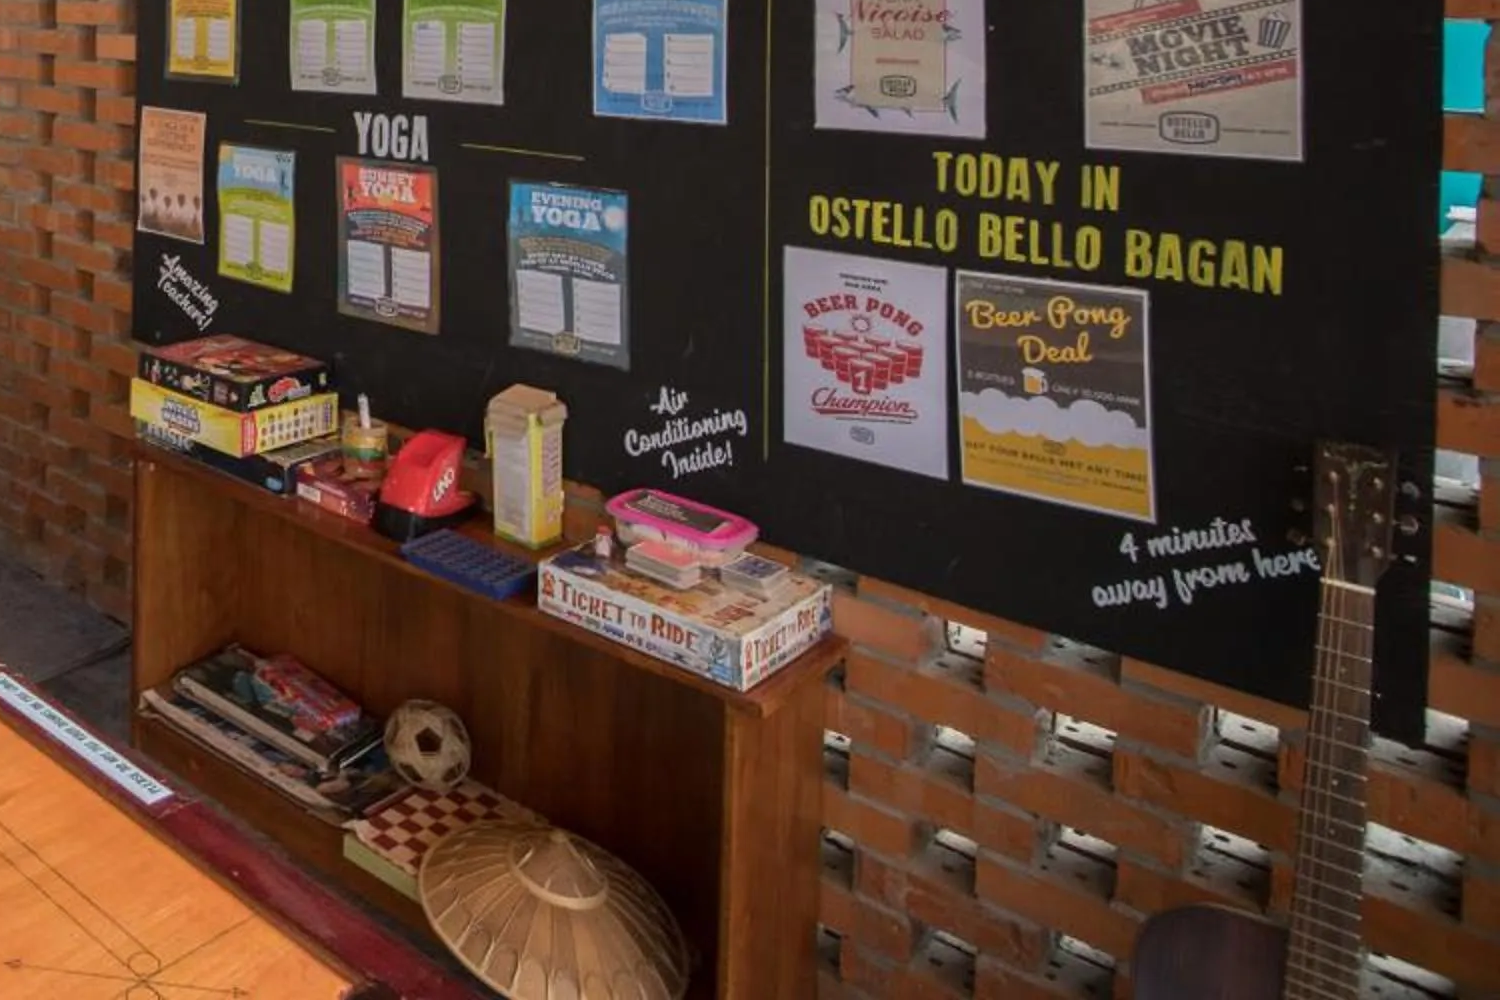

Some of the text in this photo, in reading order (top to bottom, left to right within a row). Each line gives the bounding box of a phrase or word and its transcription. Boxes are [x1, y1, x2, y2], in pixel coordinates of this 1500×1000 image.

[871, 27, 925, 41] SALAD
[1127, 15, 1247, 55] MOVIE
[1129, 35, 1250, 77] NIGHT
[354, 111, 429, 161] YOGA
[361, 181, 416, 203] YOGA
[532, 191, 603, 211] EVENING
[932, 151, 1121, 212] TODAY IN
[532, 206, 601, 231] YOGA
[810, 195, 1284, 296] OSTELLO BELLO BAGAN
[161, 254, 218, 315] Amazing
[803, 294, 924, 338] BEER PONG
[965, 295, 1132, 339] Beer Pong
[1017, 331, 1093, 364] Deal
[650, 385, 688, 415] Air
[854, 369, 868, 392] 1
[811, 386, 912, 417] Champion
[624, 408, 748, 457] Conditioning
[661, 440, 733, 479] Inside!
[432, 466, 455, 502] UNO
[1119, 516, 1257, 563] 4 minutes
[1091, 575, 1168, 610] away
[1172, 561, 1251, 605] from
[559, 578, 626, 624] TICKET
[650, 614, 699, 651] RIDE
[753, 626, 788, 661] TICKET
